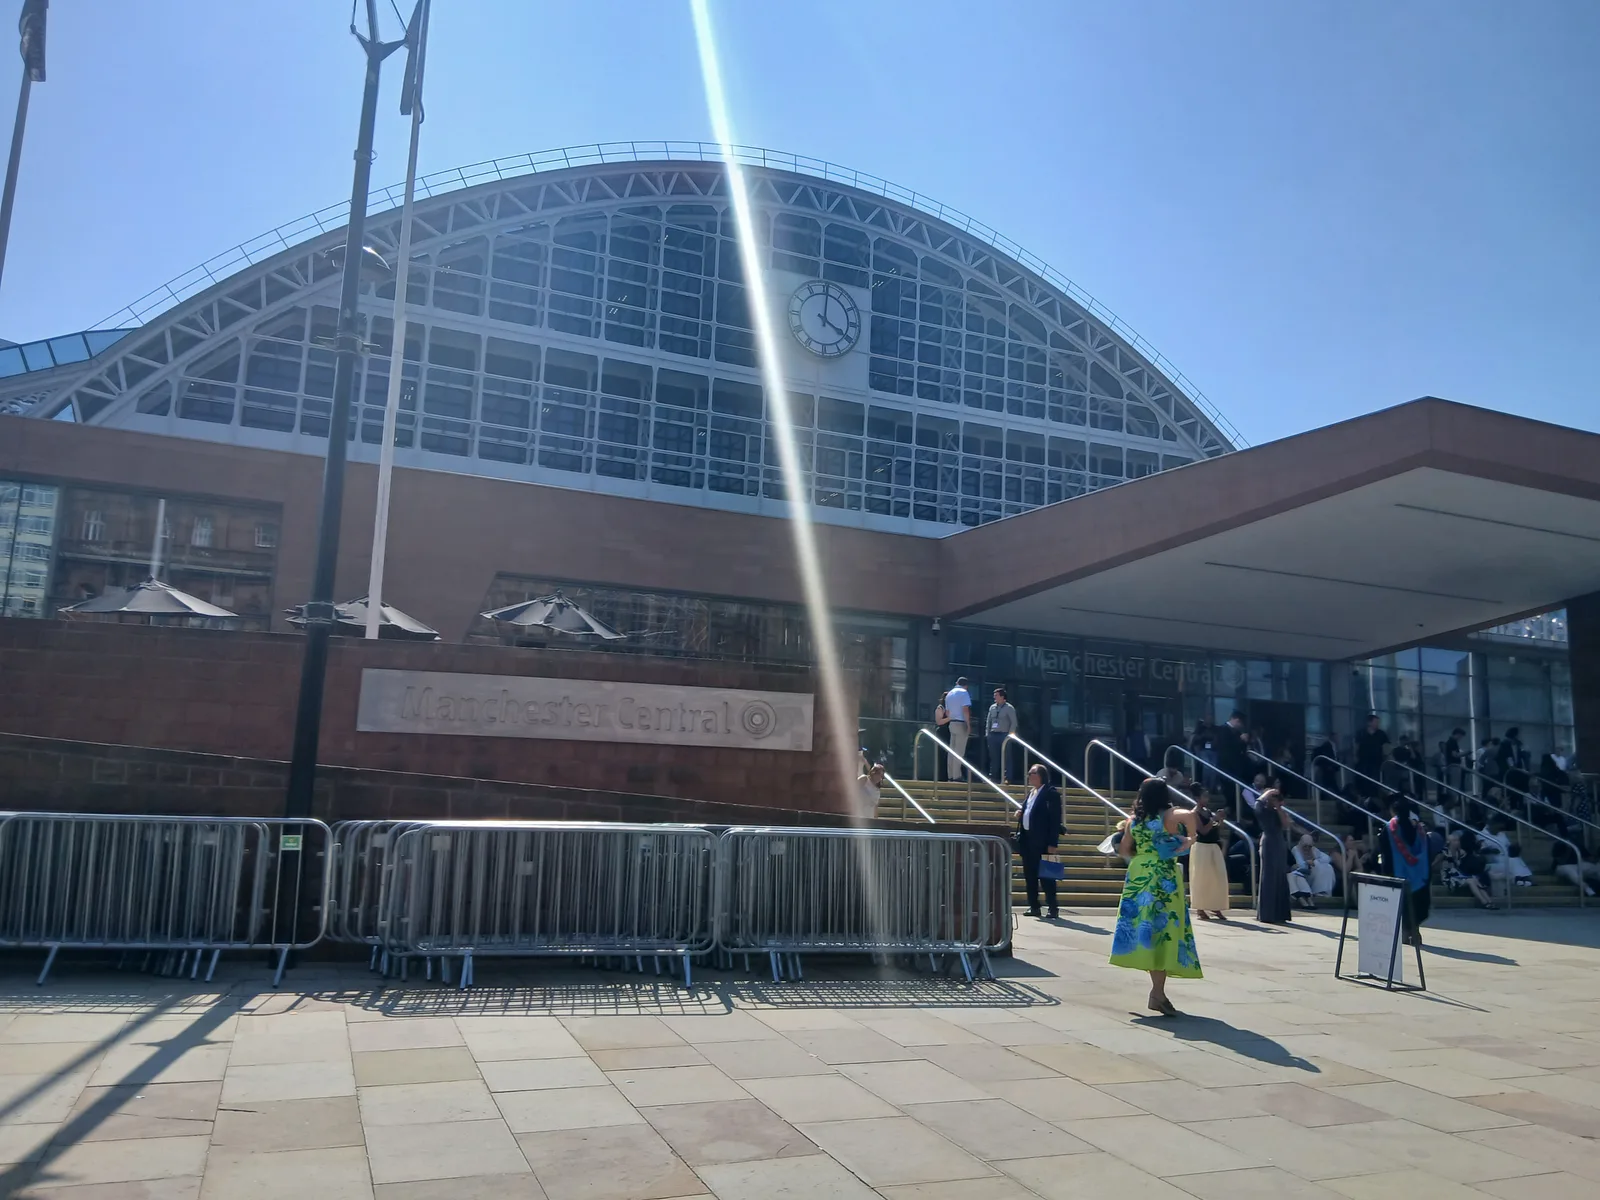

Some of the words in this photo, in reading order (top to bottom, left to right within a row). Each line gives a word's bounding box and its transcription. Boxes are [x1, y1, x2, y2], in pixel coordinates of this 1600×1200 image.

[1026, 645, 1145, 679] Manchester
[401, 685, 606, 729] Manchester
[618, 697, 731, 735] Central
